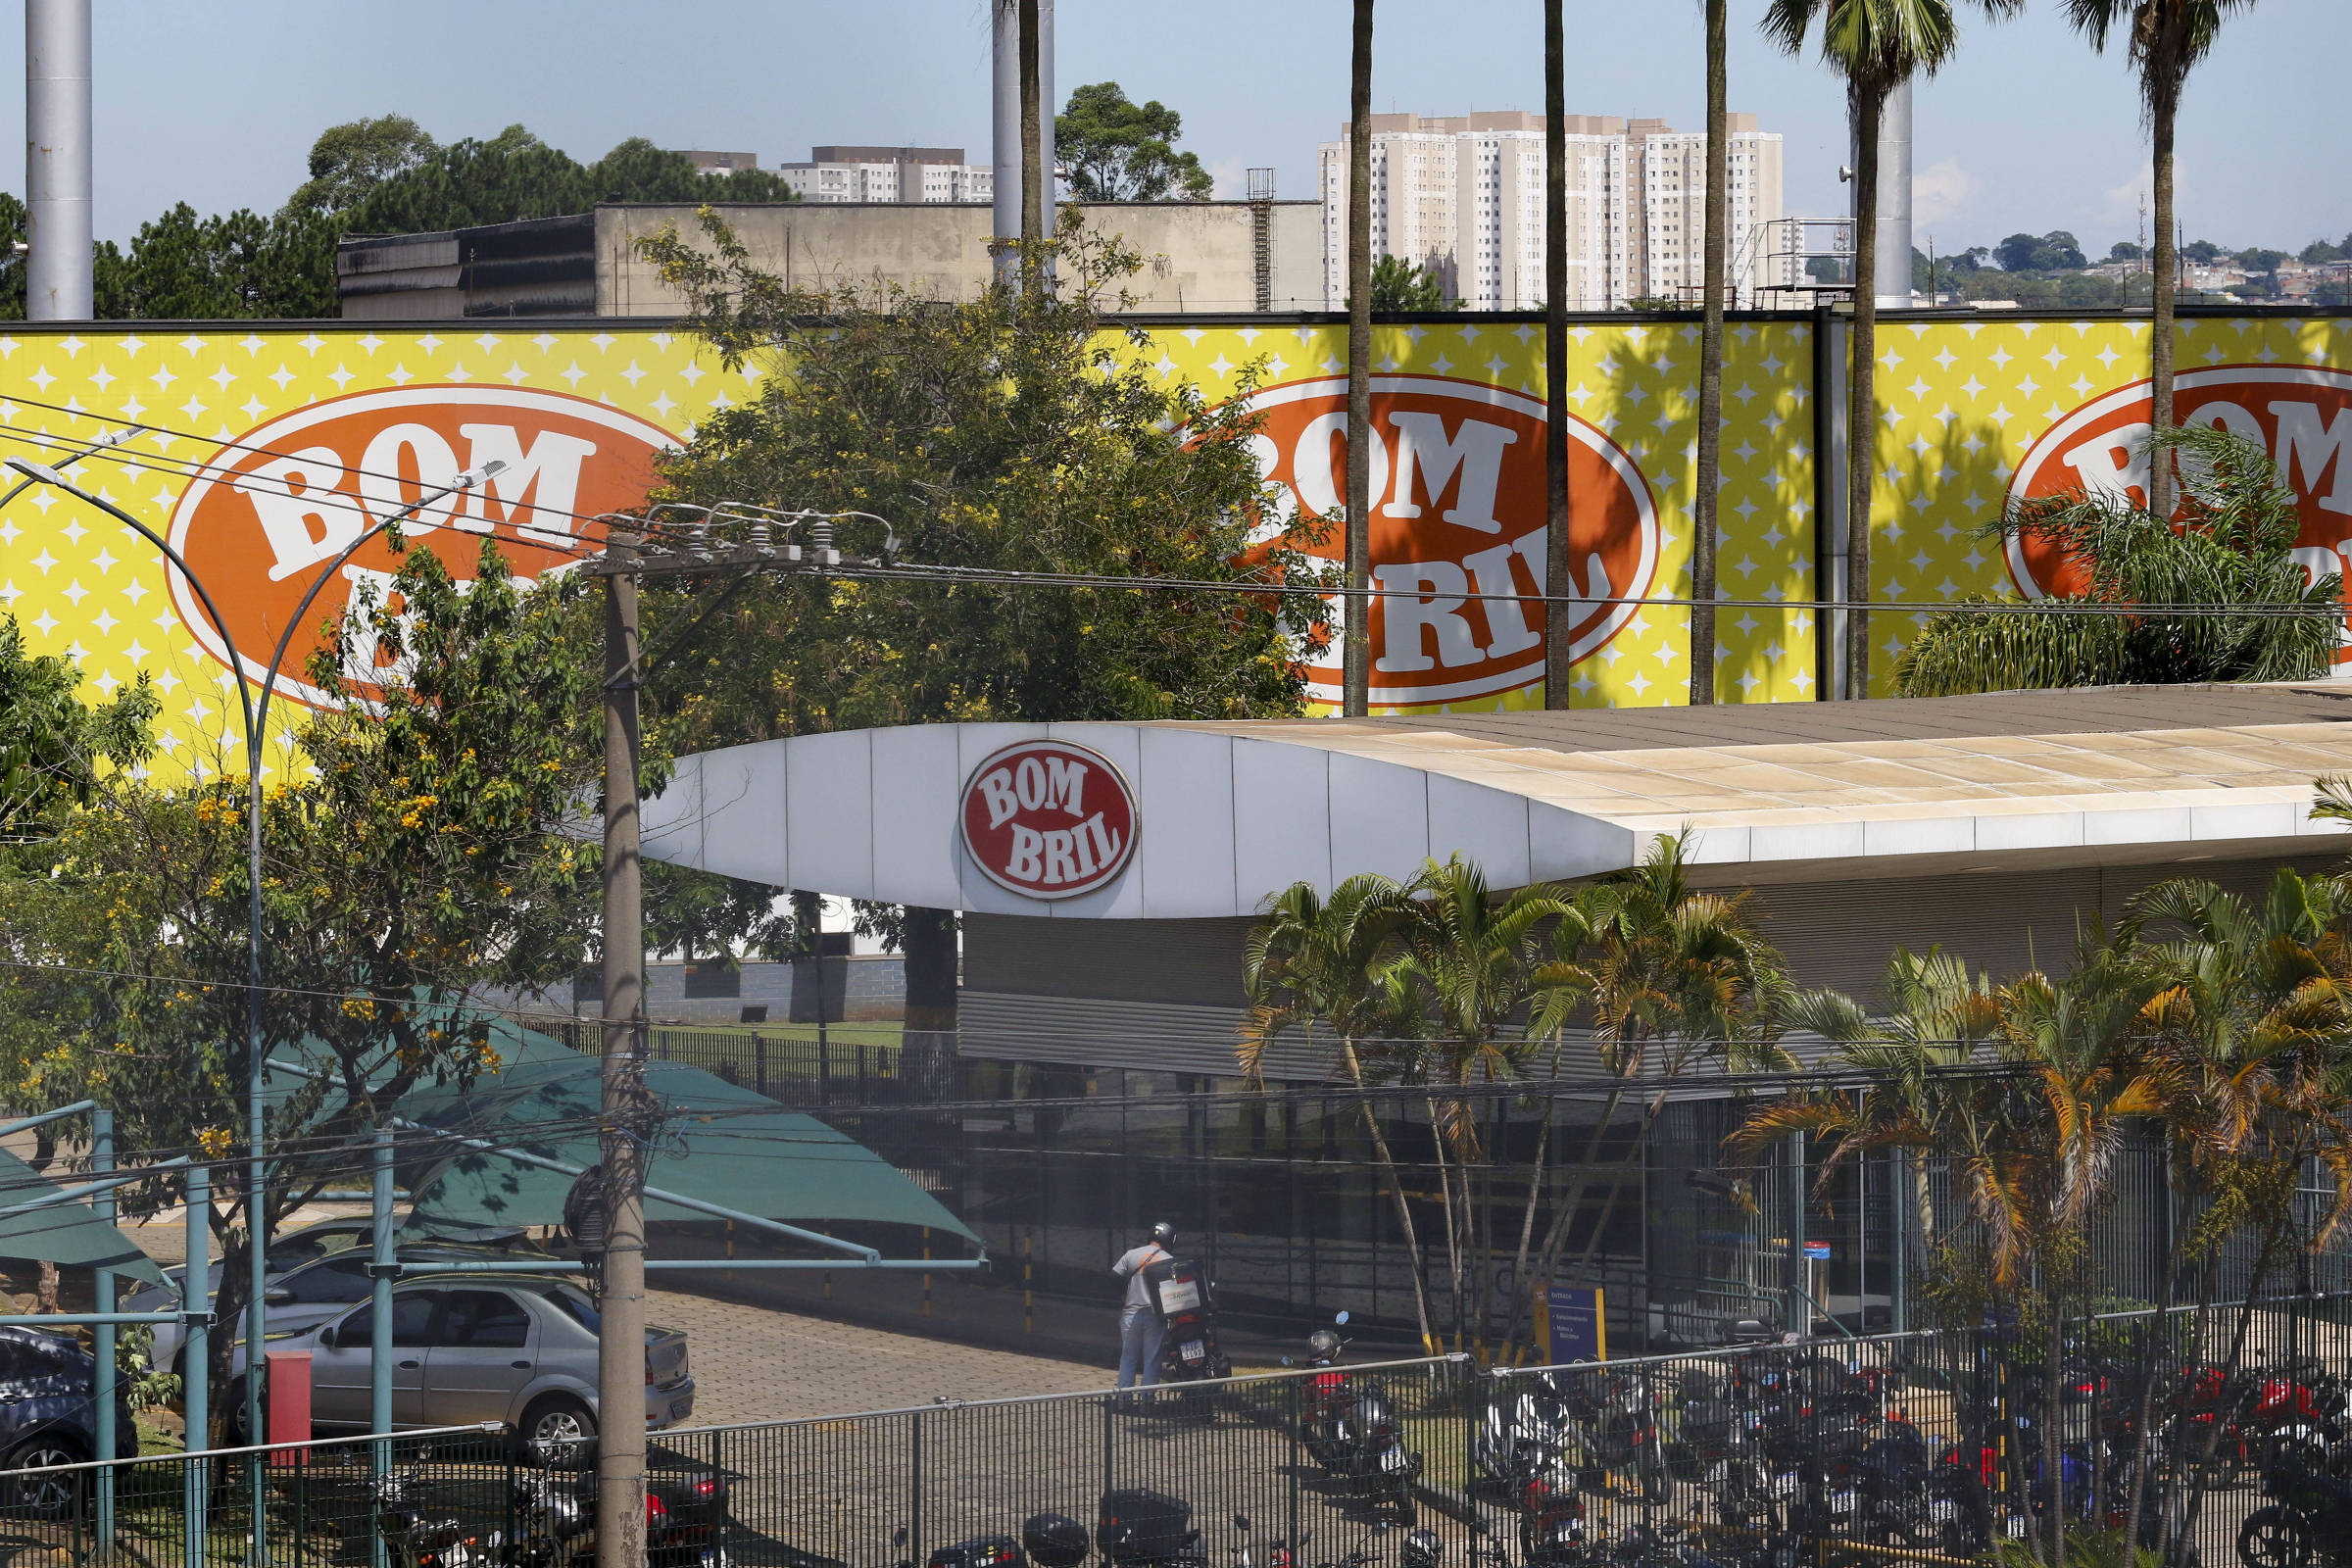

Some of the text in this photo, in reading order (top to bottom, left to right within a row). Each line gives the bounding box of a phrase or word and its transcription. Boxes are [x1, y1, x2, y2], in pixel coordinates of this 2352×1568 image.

[233, 423, 597, 581] BOM
[978, 757, 1089, 830] BOM
[1005, 811, 1121, 884] BRIL
